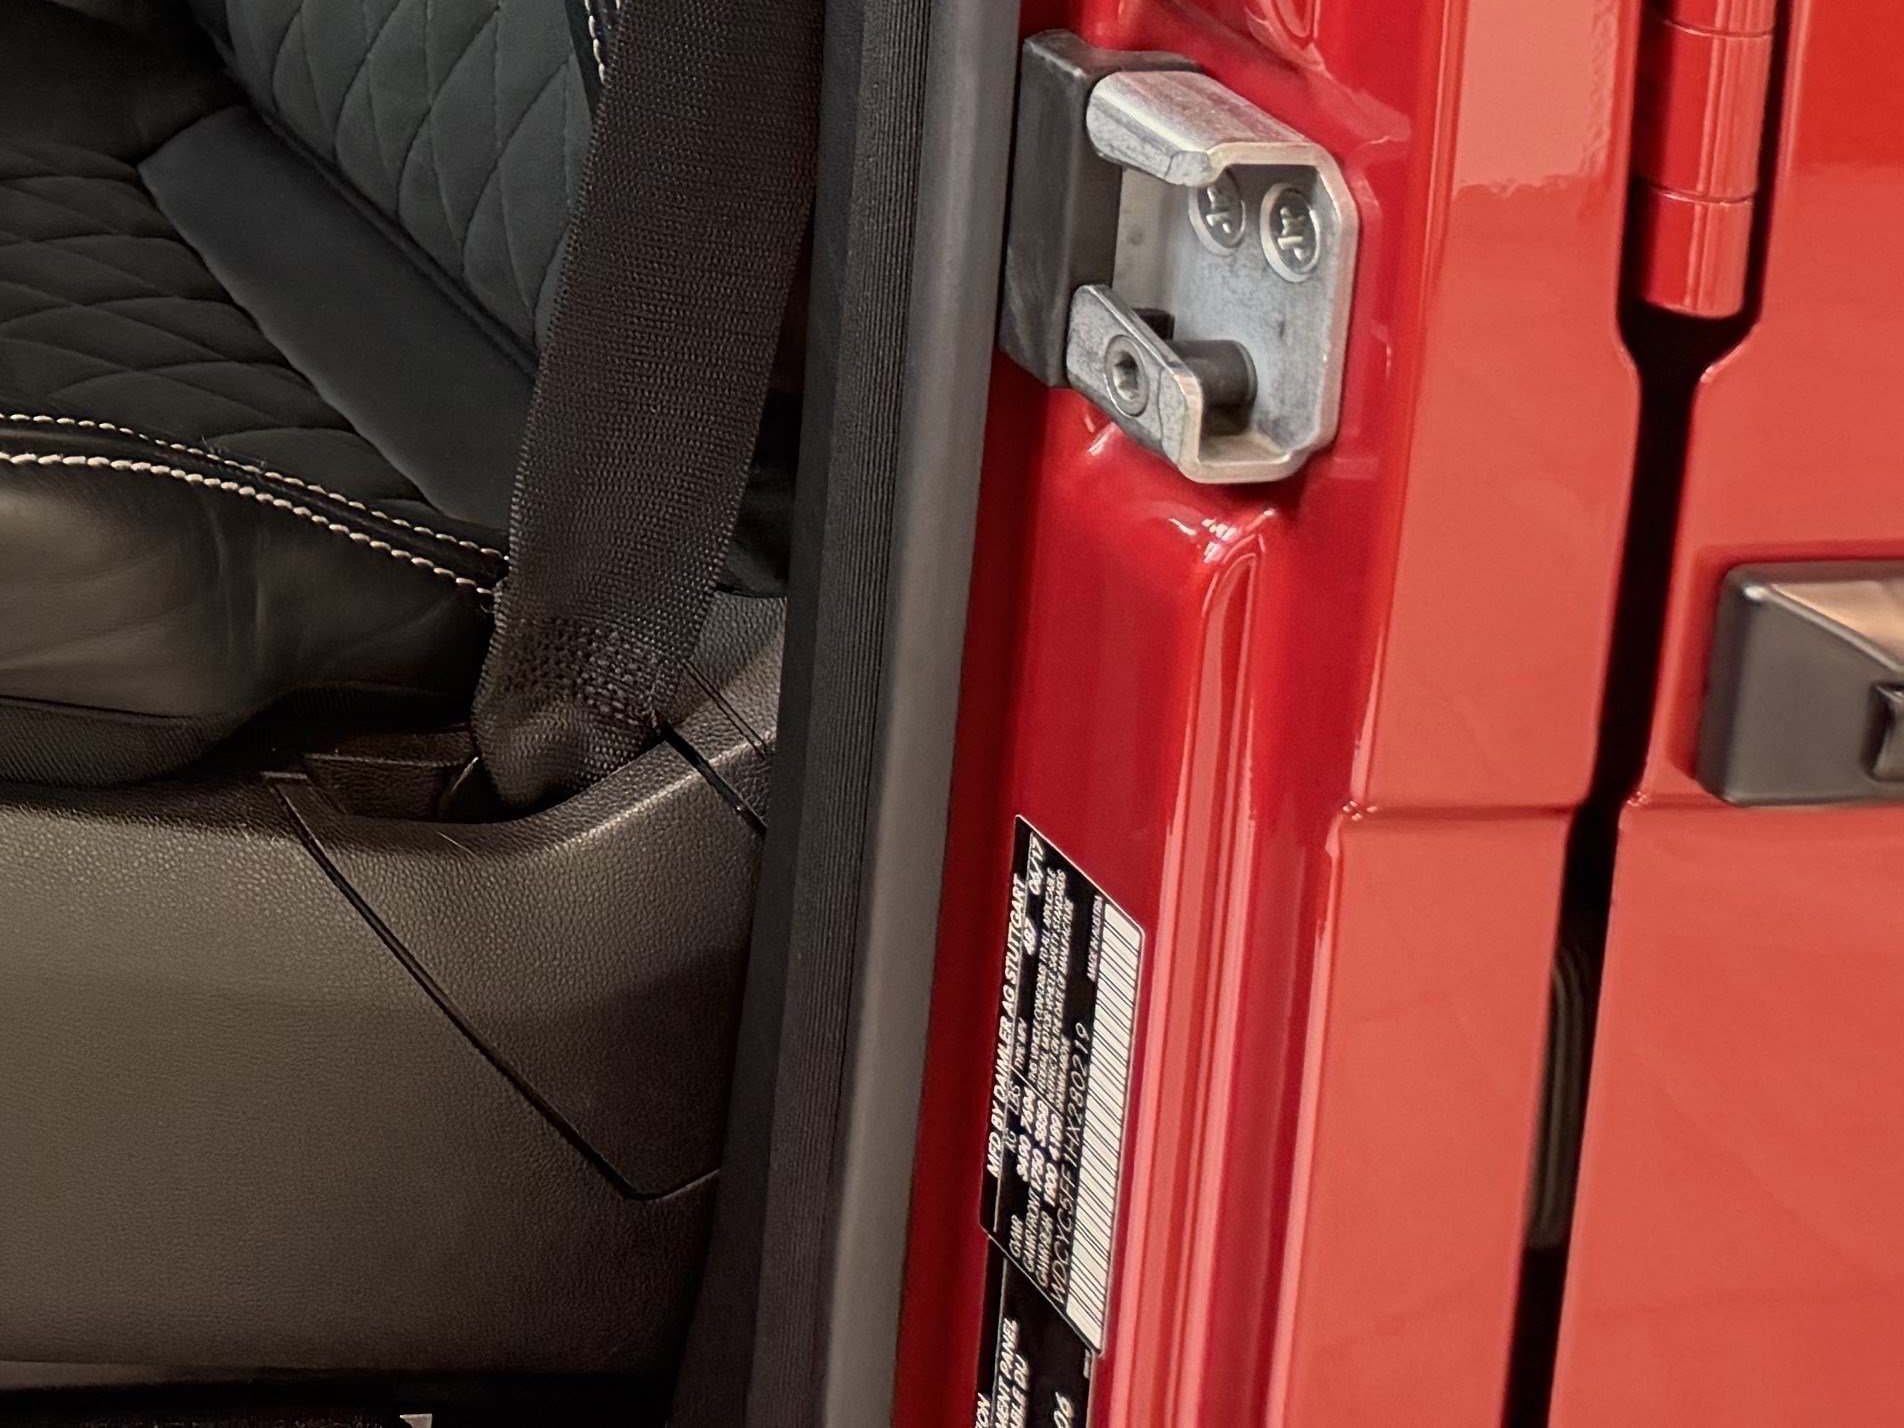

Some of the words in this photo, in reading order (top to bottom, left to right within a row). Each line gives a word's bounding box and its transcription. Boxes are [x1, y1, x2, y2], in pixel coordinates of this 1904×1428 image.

[1028, 836, 1044, 895] 06/17
[1004, 873, 1025, 984] STUTTGART
[1001, 984, 1015, 1018] AG
[993, 1016, 1012, 1103] DAIMLER
[990, 1100, 1005, 1132] BY
[1020, 1086, 1036, 1134] 7694
[986, 1131, 1002, 1178] MFD
[1048, 1113, 1062, 1161] 4189
[1030, 1148, 1045, 1192] 1750
[1000, 1318, 1019, 1380] PANEL
